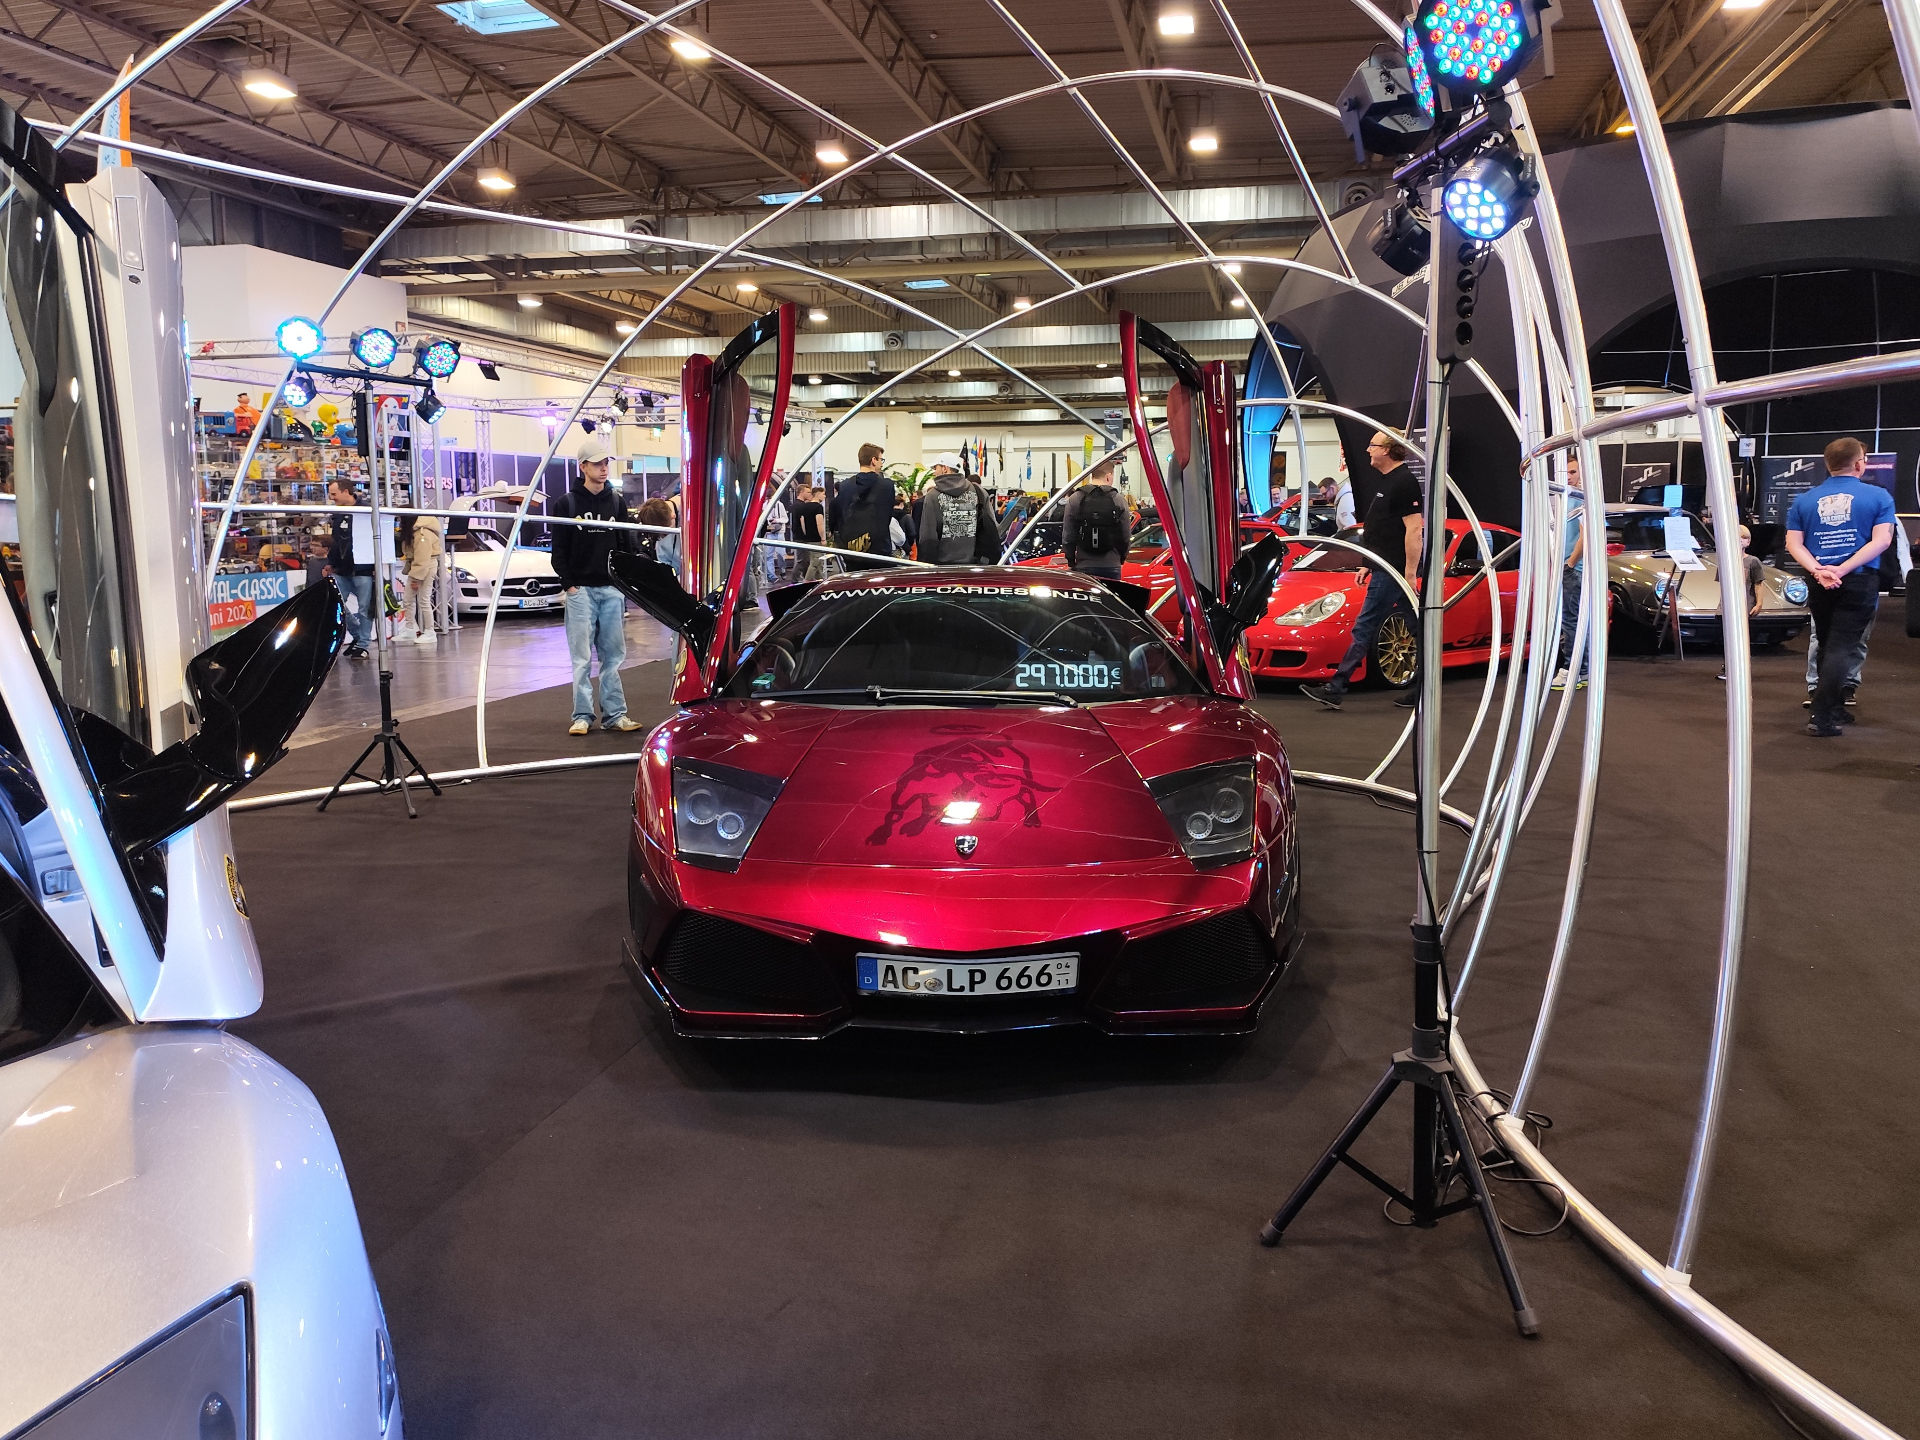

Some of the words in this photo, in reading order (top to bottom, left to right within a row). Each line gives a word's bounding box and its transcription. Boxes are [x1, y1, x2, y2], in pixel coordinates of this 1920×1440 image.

[226, 604, 253, 623] 2026
[1056, 961, 1071, 969] 04
[864, 976, 873, 984] D
[882, 965, 920, 990] AC
[947, 968, 987, 992] LP
[995, 963, 1053, 991] 666
[1056, 978, 1070, 986] 11
